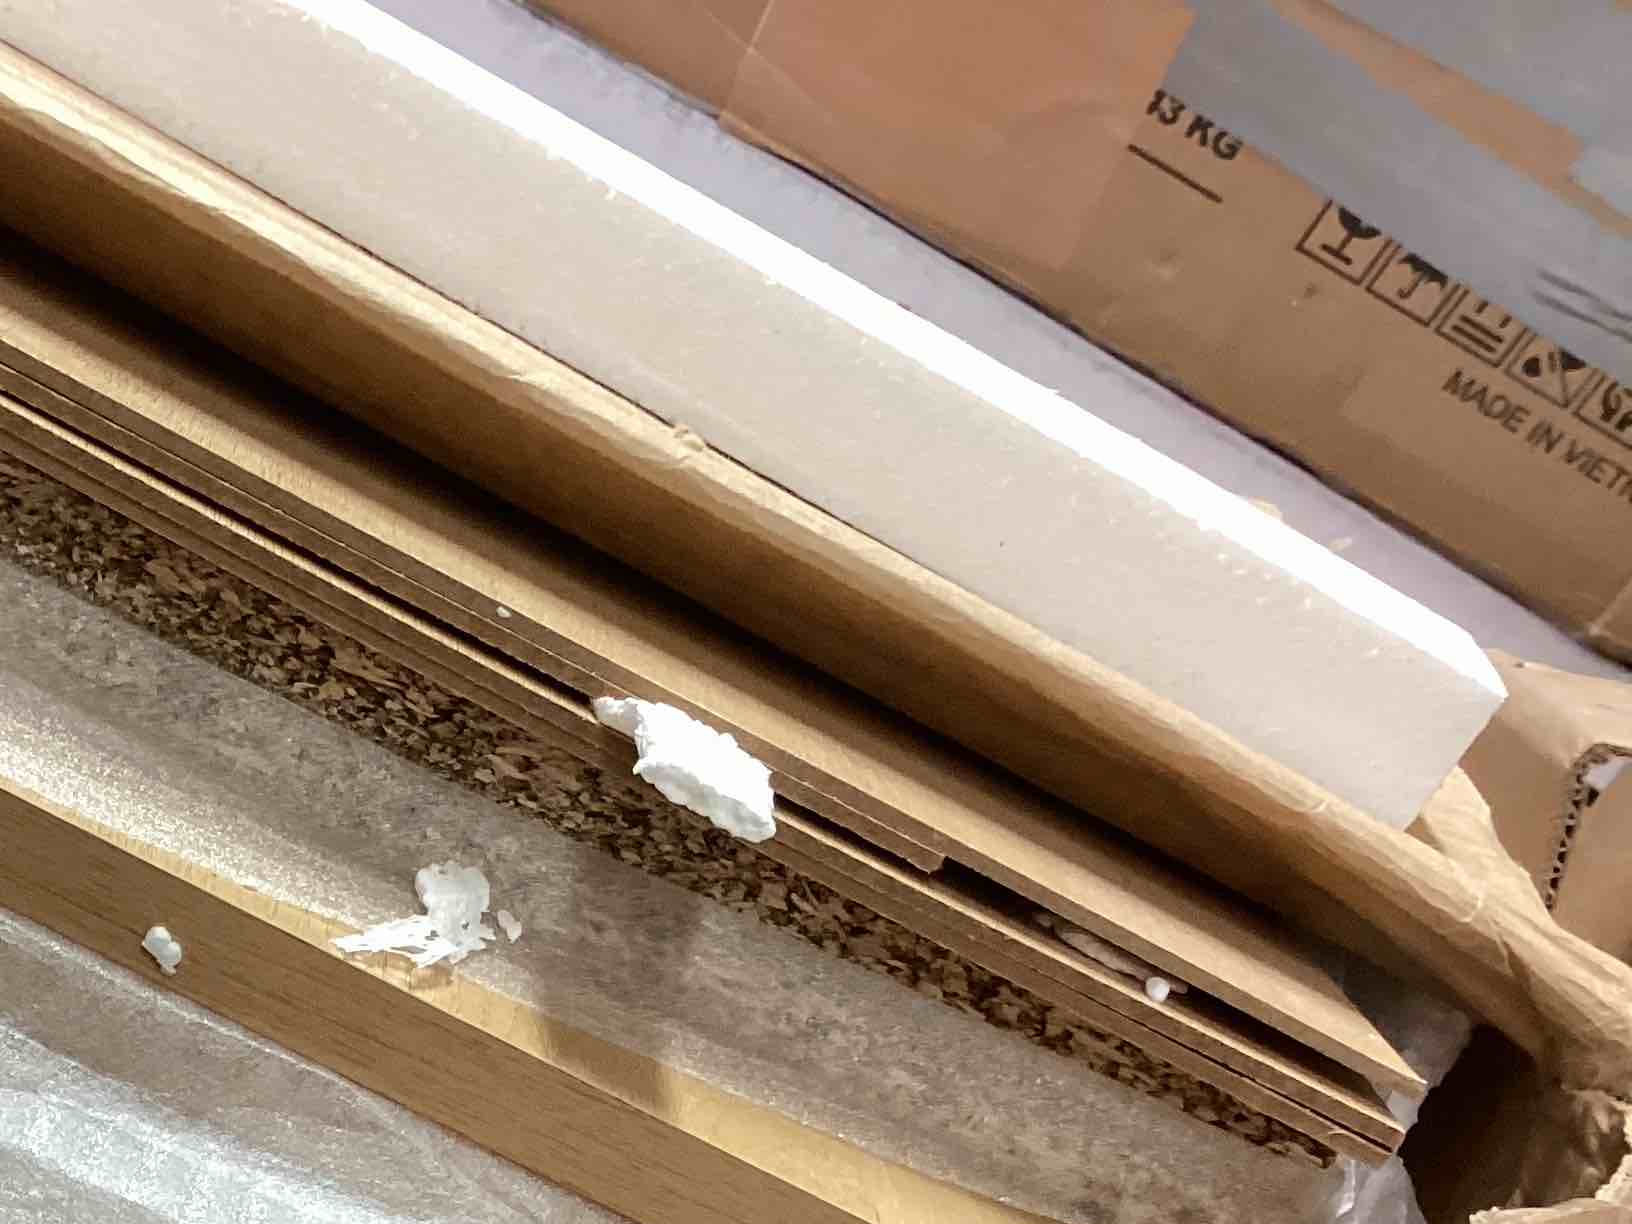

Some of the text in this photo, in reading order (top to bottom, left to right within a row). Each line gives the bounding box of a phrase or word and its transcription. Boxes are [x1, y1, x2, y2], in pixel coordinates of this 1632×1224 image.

[1185, 114, 1243, 161] KG
[1442, 370, 1531, 433] MADE
[1525, 419, 1565, 454] IN
